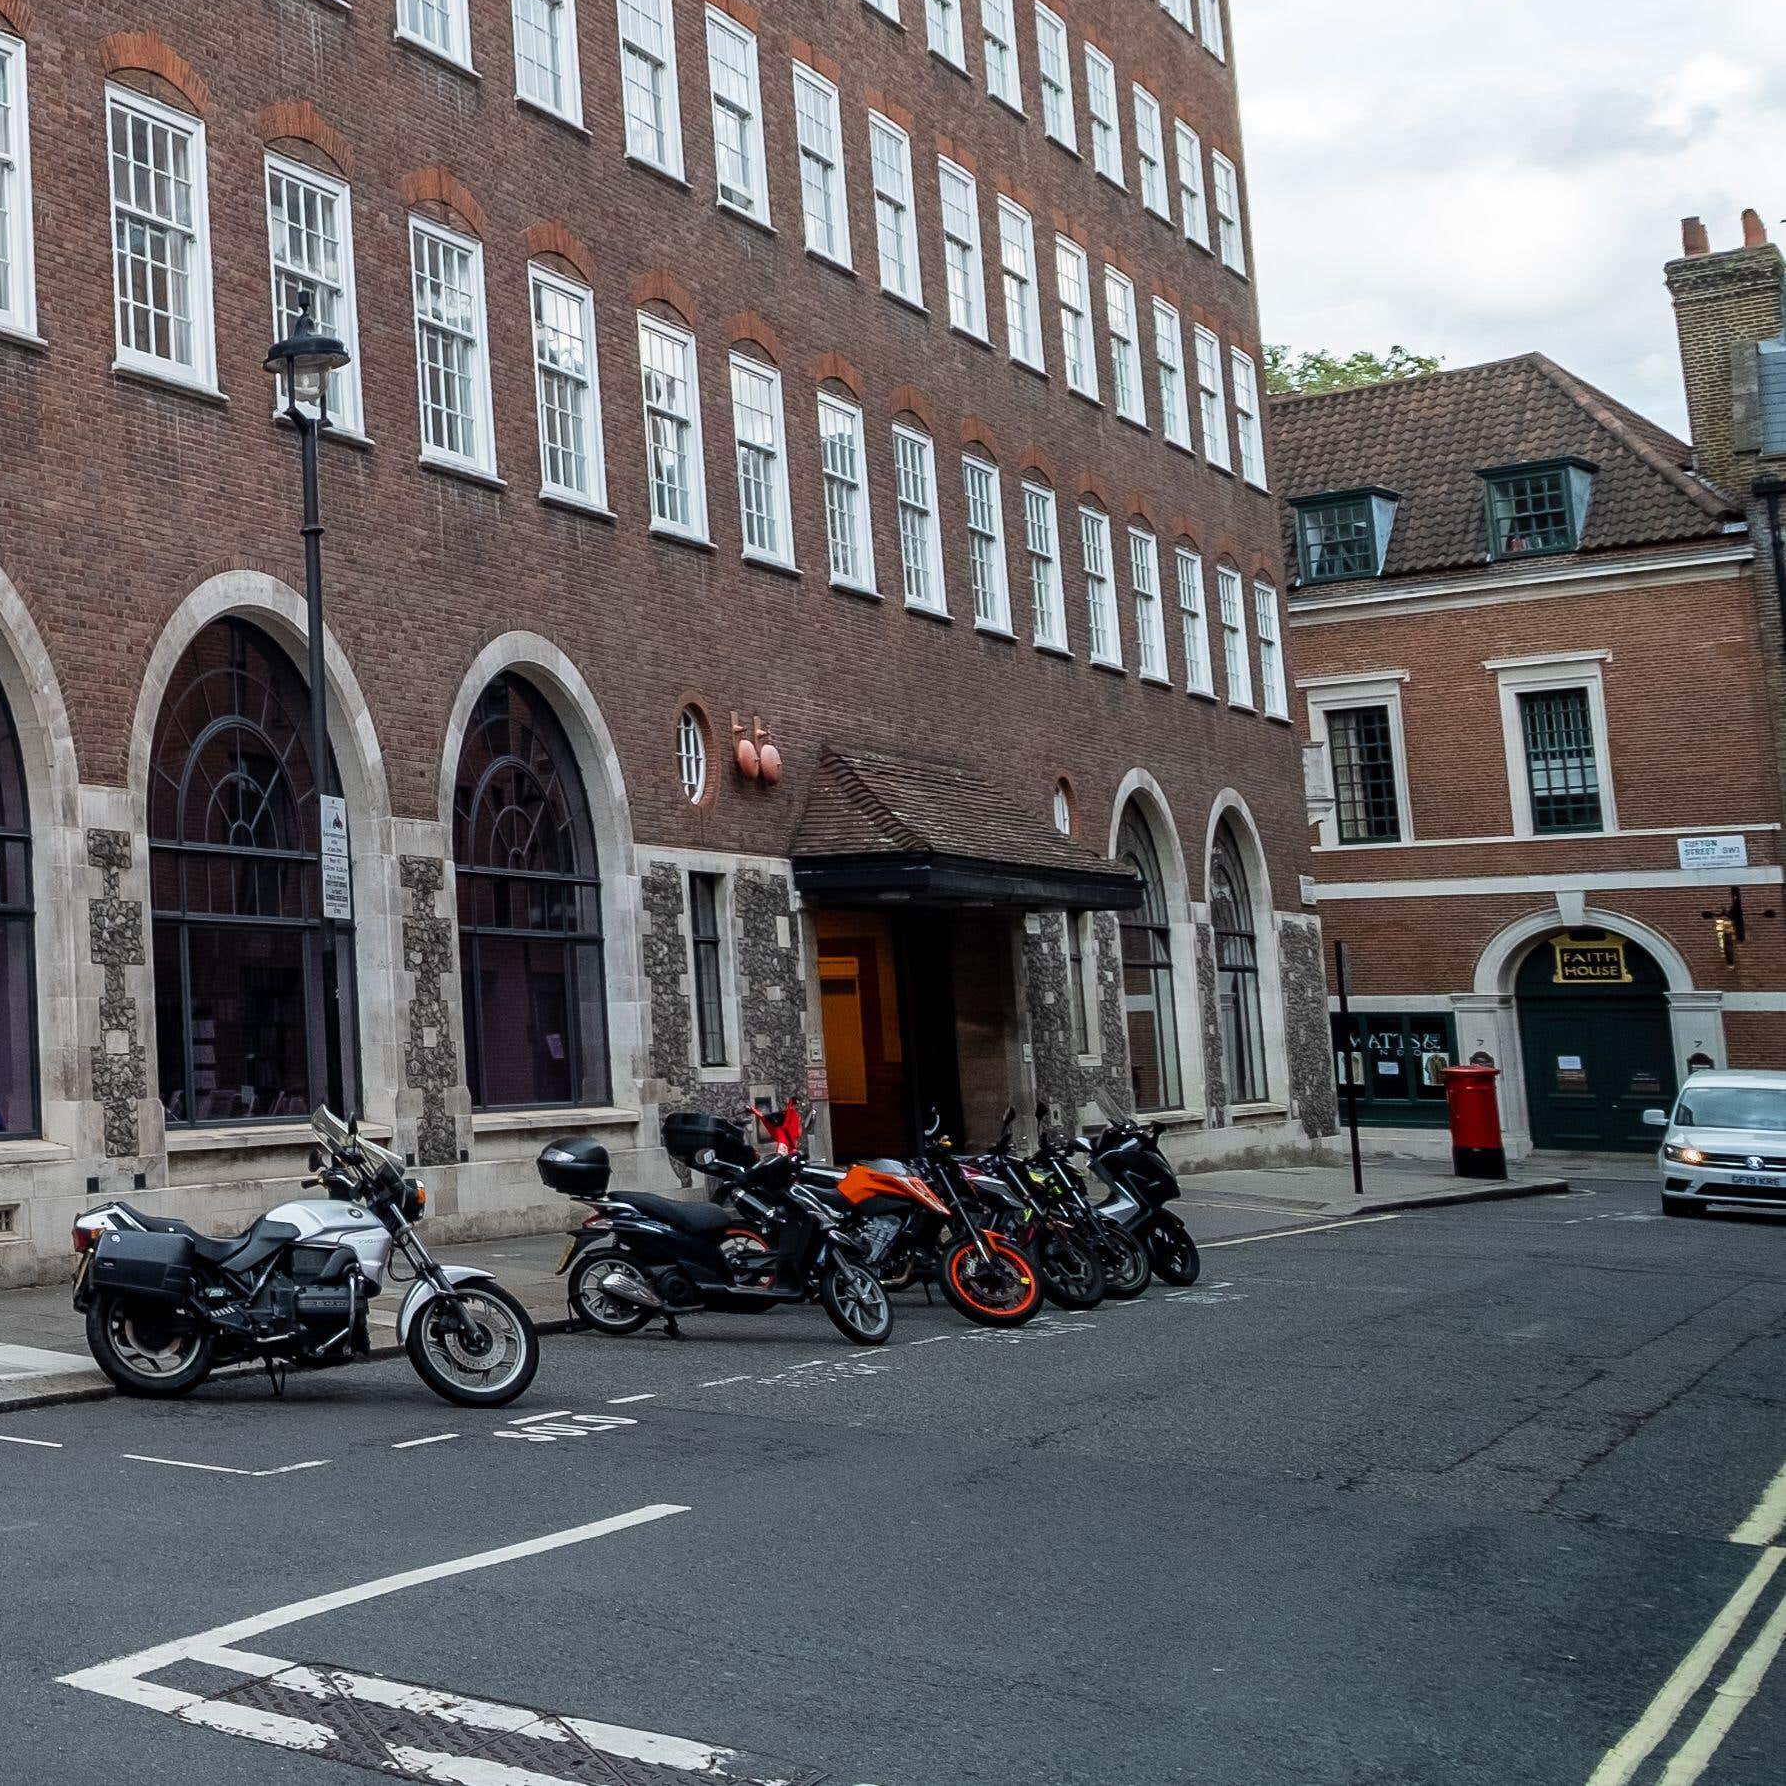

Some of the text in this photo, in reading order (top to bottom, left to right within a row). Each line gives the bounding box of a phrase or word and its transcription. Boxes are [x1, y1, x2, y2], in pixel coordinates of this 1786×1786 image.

[1683, 847, 1716, 857] STREET
[1563, 952, 1618, 963] FAITH
[1564, 965, 1619, 977] HOUSE
[493, 1414, 638, 1442] SOLO
